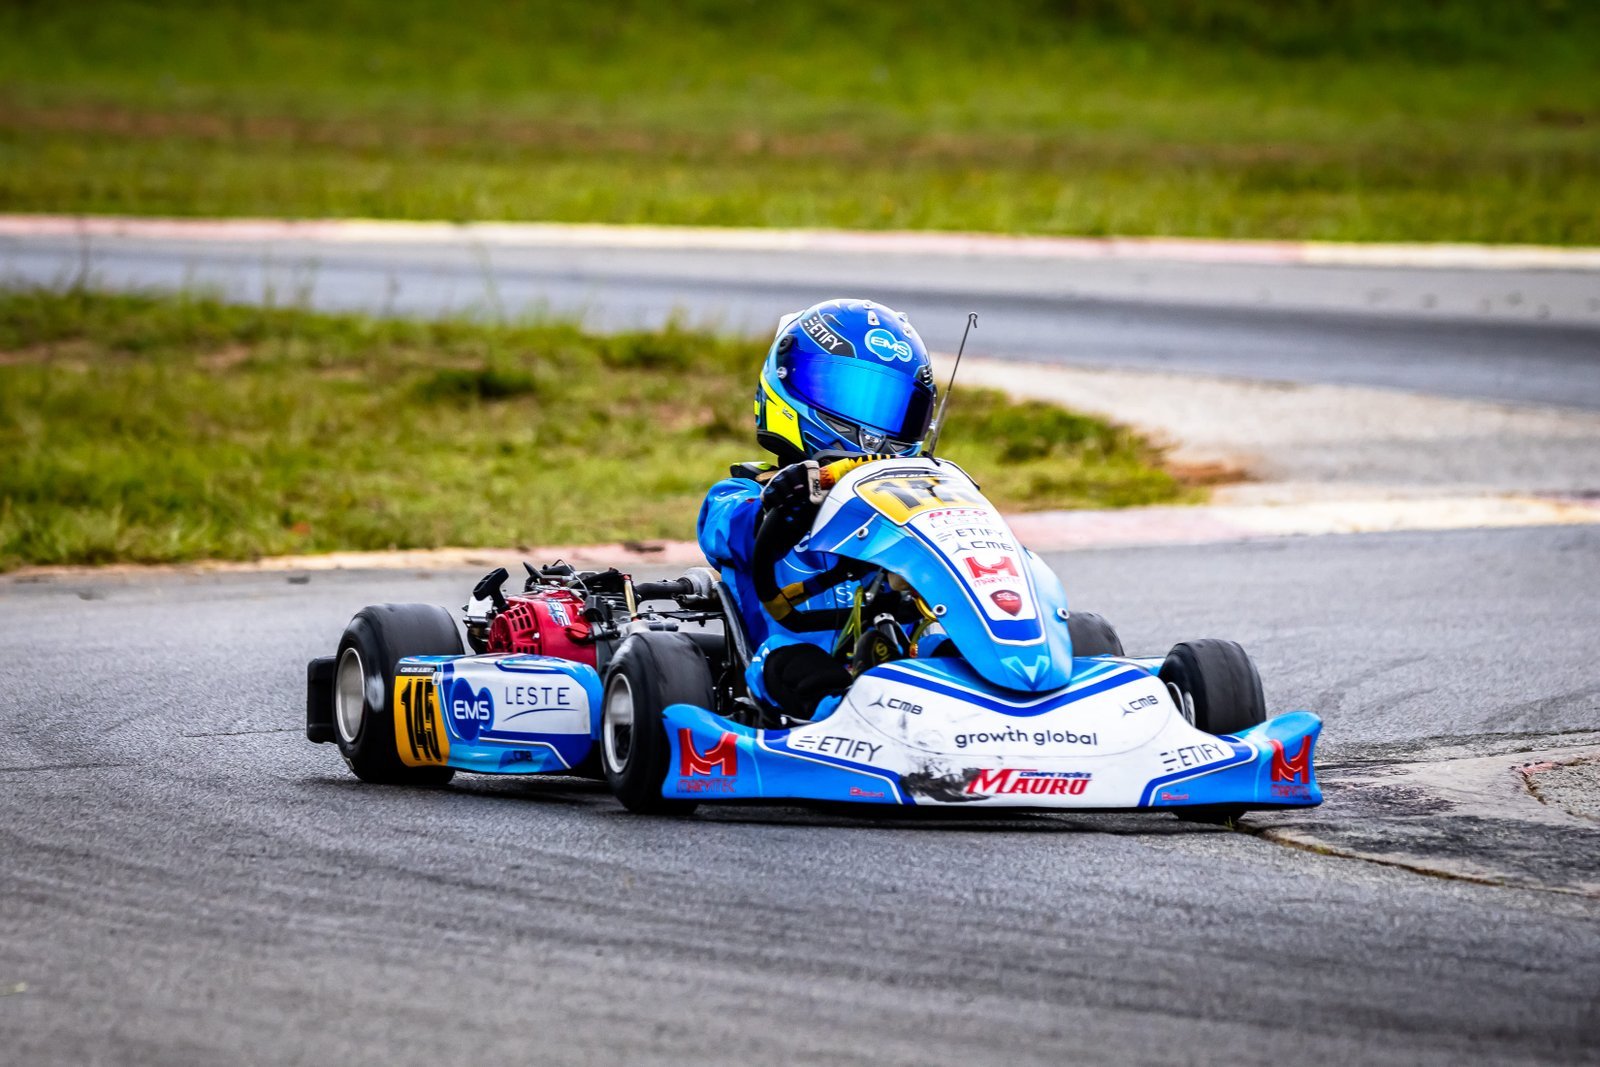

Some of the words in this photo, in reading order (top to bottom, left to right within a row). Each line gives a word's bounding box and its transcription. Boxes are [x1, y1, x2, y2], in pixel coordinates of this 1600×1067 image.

[870, 335, 909, 357] EMS
[505, 686, 571, 705] LESTE
[886, 697, 923, 716] CMB
[1129, 694, 1159, 711] CMB
[400, 678, 442, 762] 145
[453, 699, 490, 721] EMS
[954, 725, 1028, 748] growth
[1033, 729, 1098, 746] global
[965, 768, 1092, 795] MAURO
